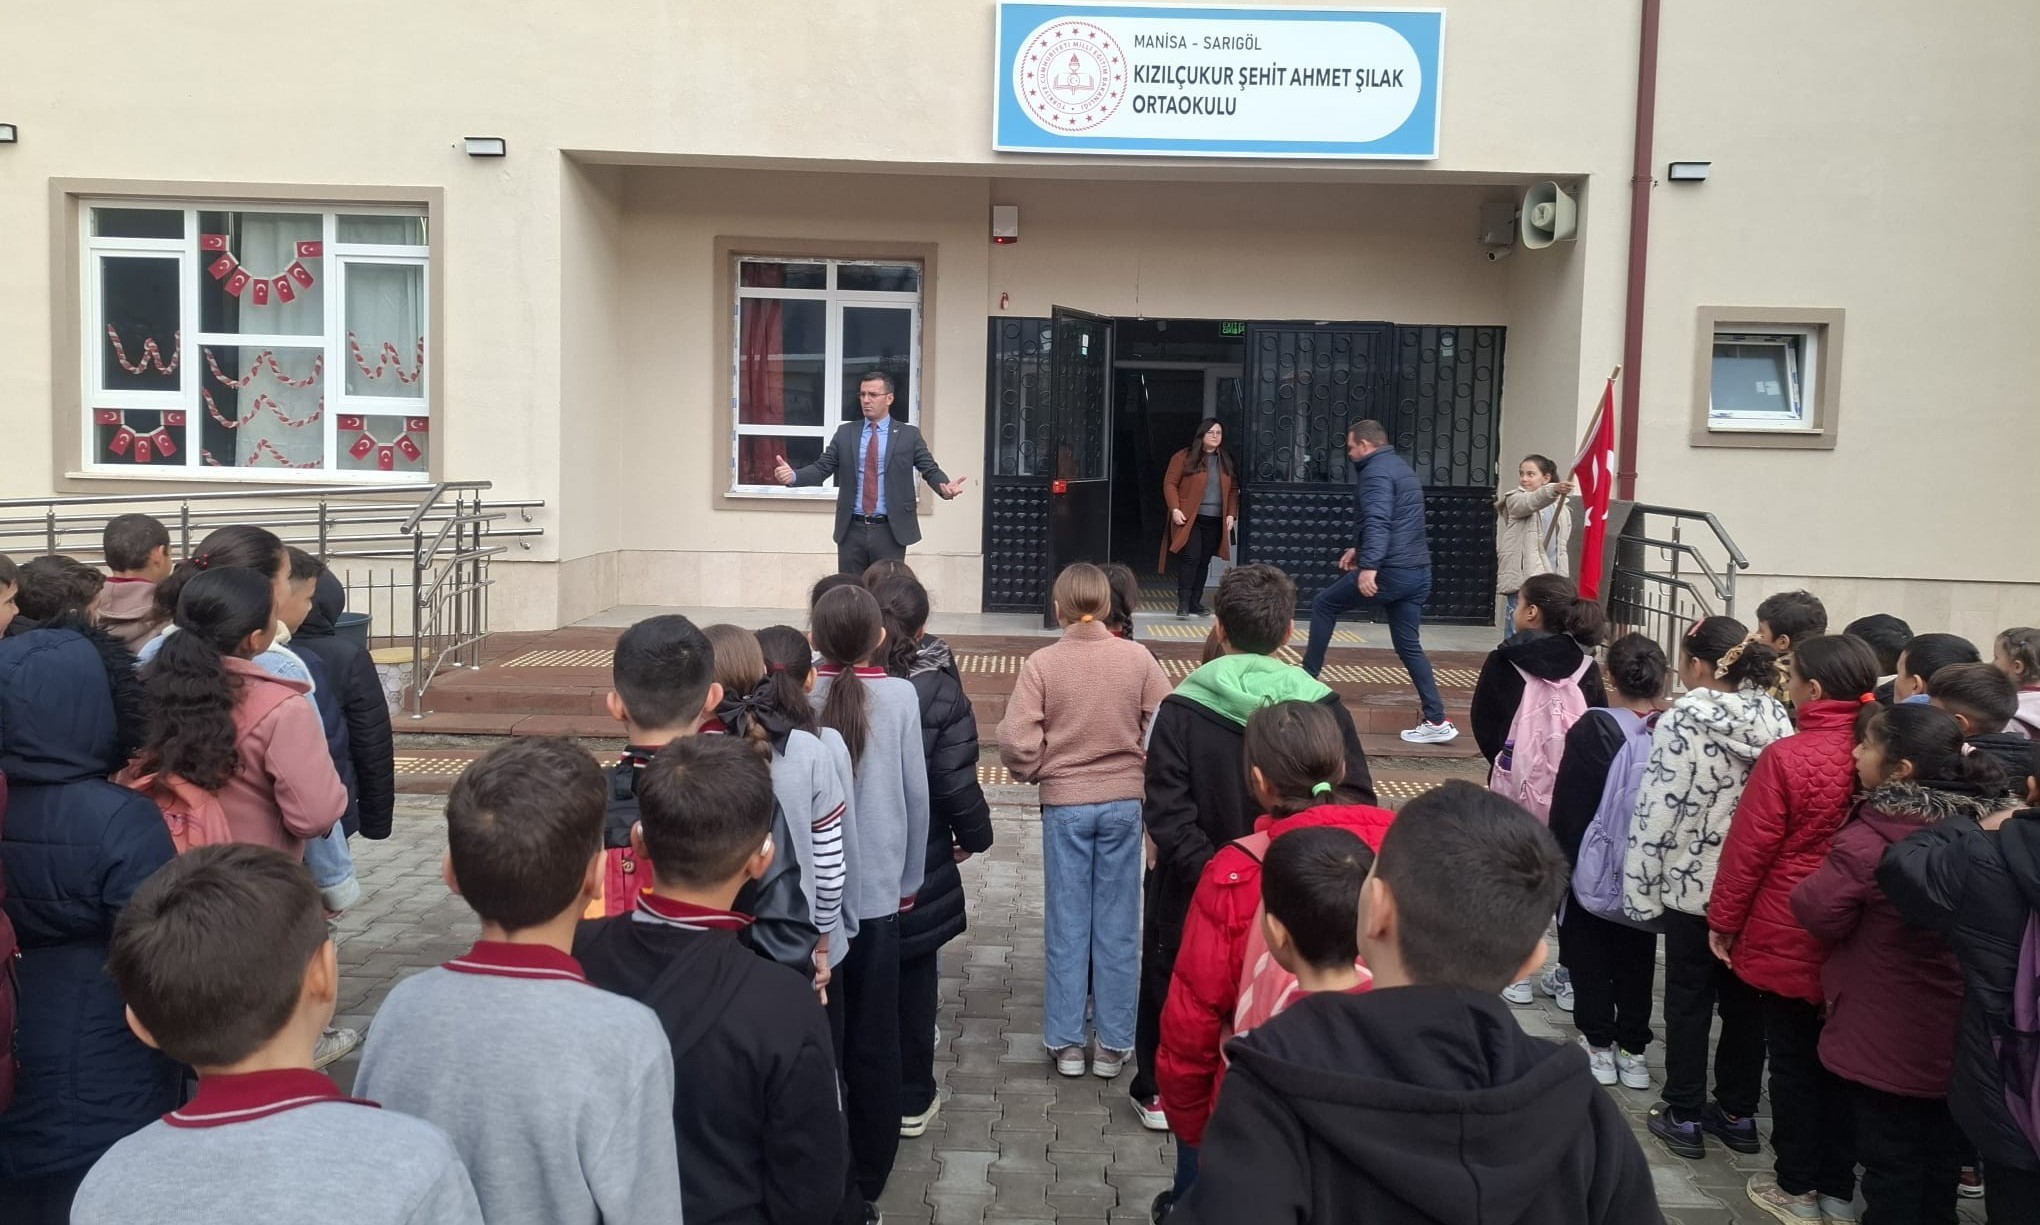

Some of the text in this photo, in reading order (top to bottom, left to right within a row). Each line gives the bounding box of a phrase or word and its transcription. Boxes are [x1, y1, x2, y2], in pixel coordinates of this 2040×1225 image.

[1134, 32, 1187, 49] MANİSA
[1203, 33, 1262, 51] SARIGÖL
[1133, 61, 1404, 93] KIZILÇUKUR ŞEHİT AHMET ŞILAK
[1132, 94, 1237, 116] ORTAOKULU
